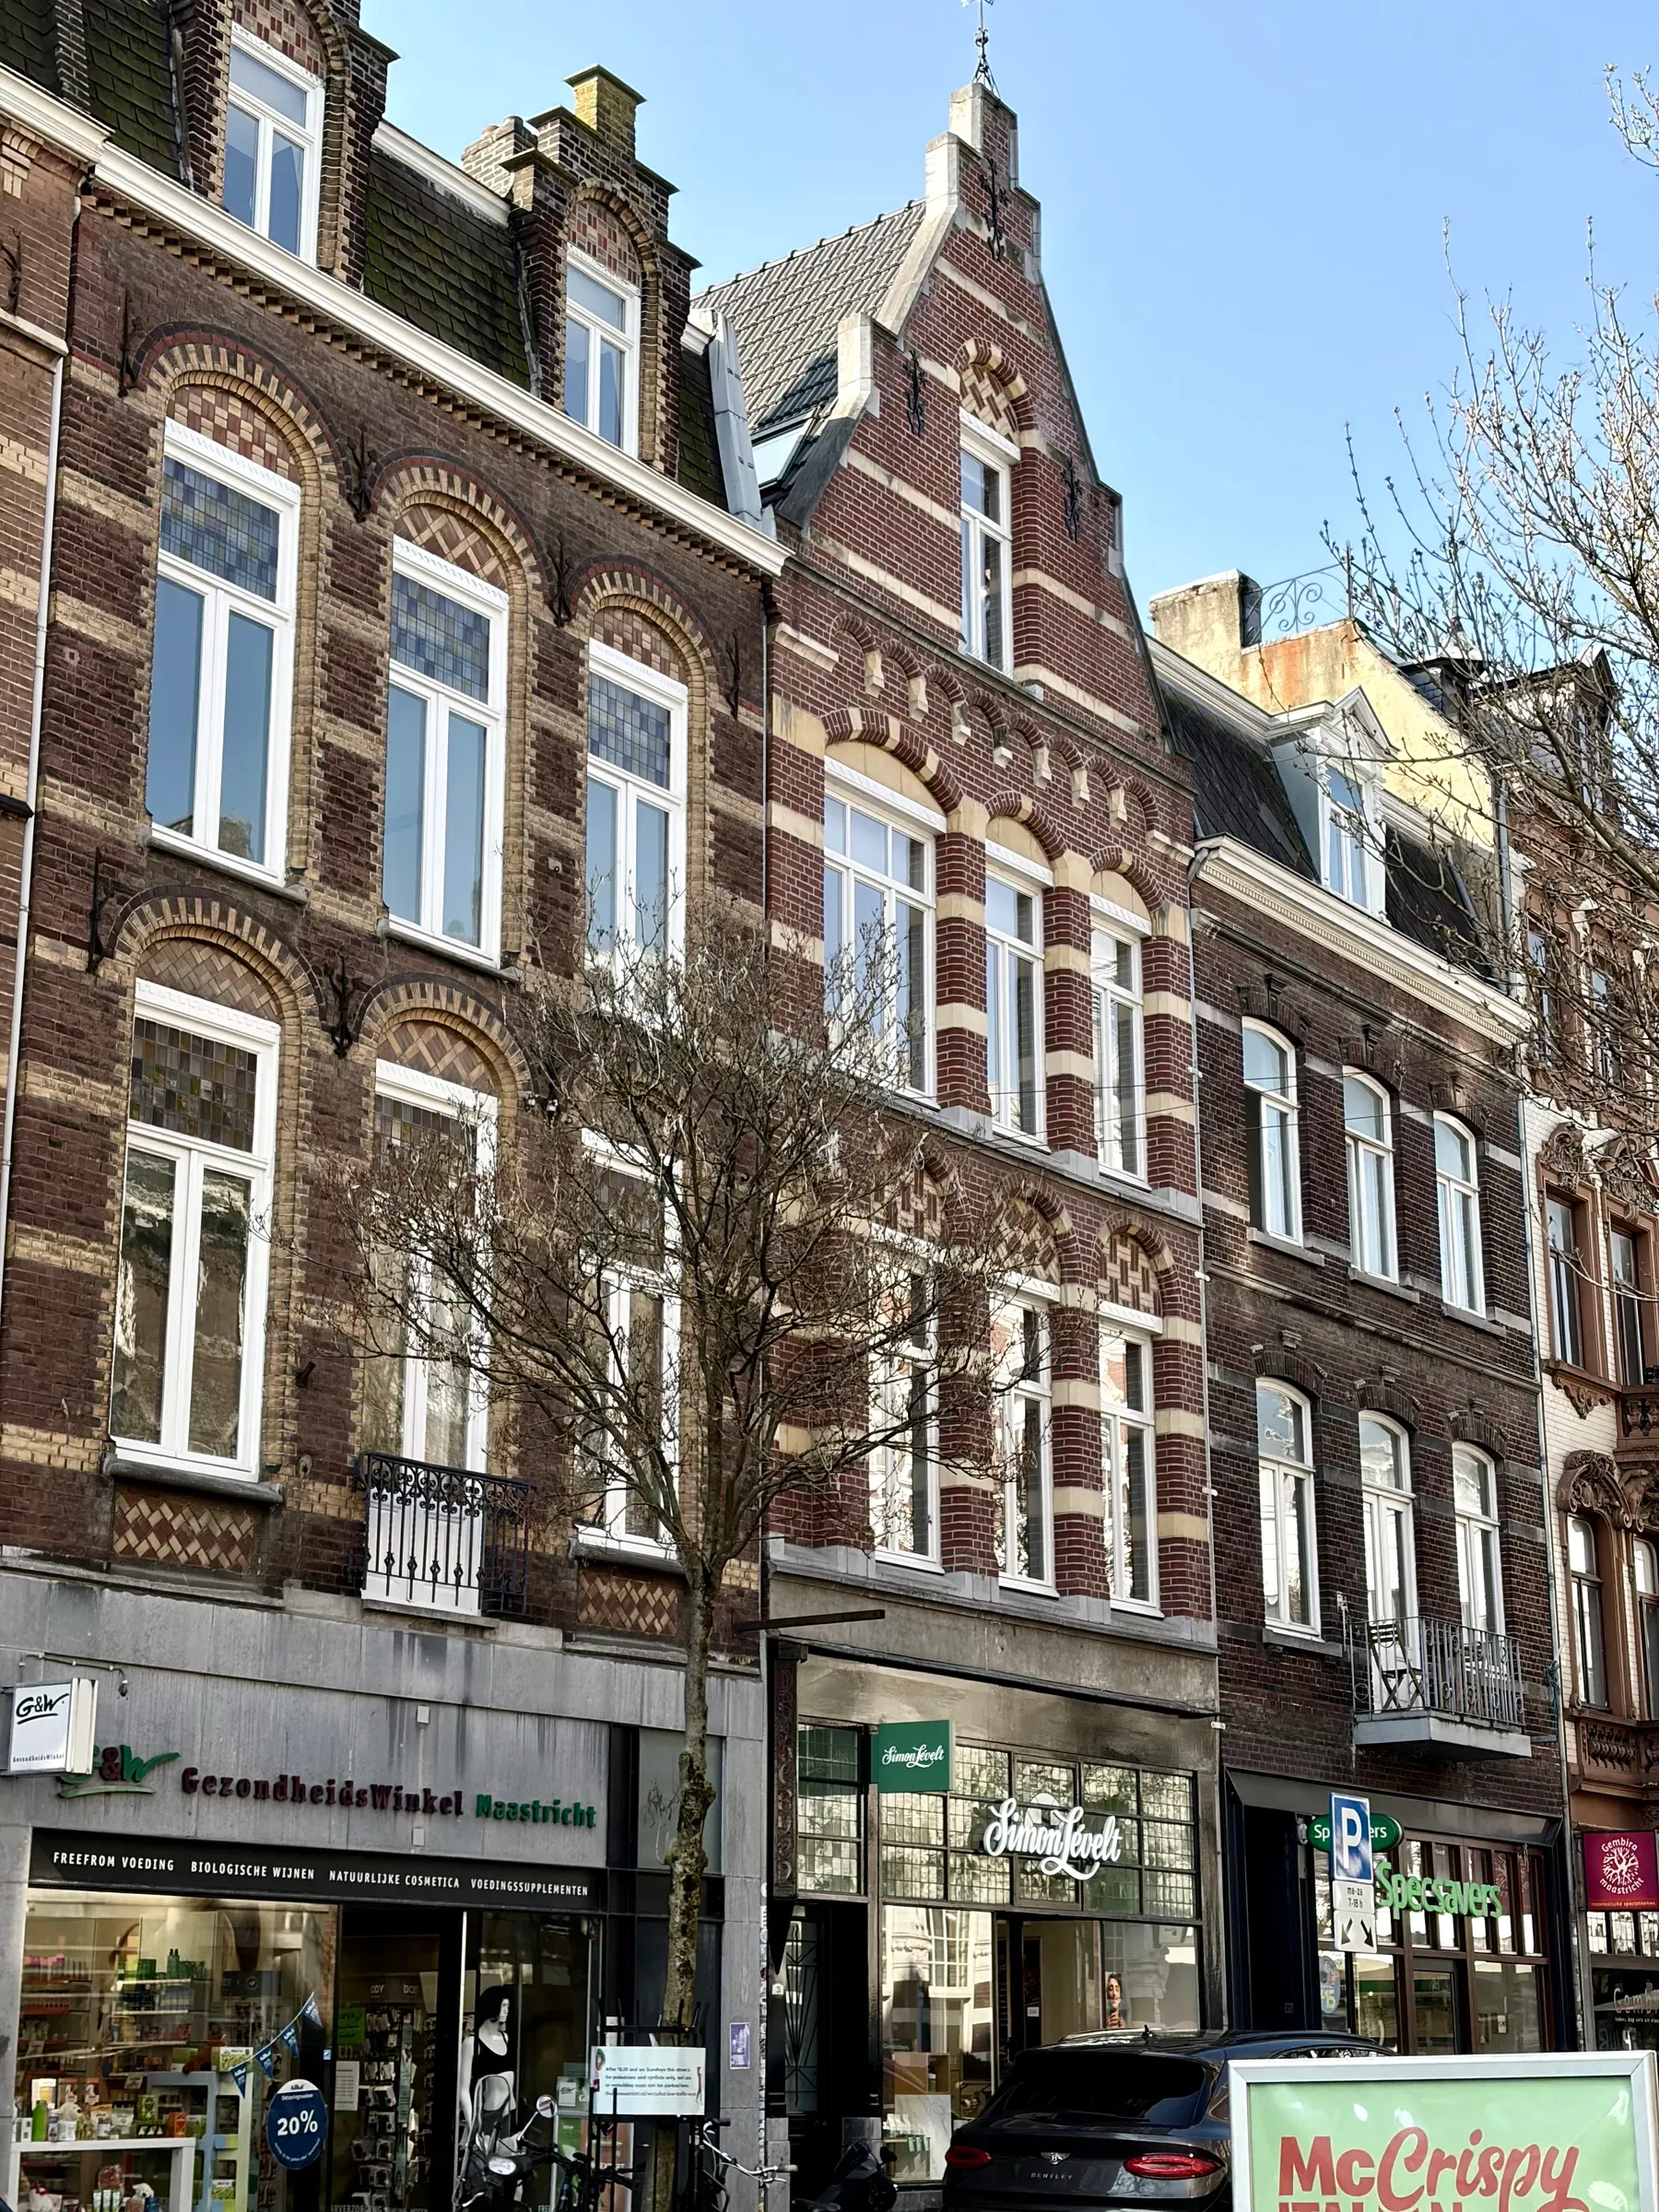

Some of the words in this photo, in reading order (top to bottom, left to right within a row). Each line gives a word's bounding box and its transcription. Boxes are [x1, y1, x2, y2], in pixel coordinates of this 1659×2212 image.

[16, 1693, 69, 1717] G&W
[182, 1767, 464, 1817] GezondheidsWinkel
[476, 1794, 597, 1829] Maastricht
[1341, 1806, 1362, 1869] P
[1601, 1836, 1638, 1853] Gembira
[53, 1852, 115, 1867] FREEFROM
[122, 1856, 174, 1871] VOEDING
[191, 1861, 267, 1877] BIOLOGISCHE
[273, 1866, 315, 1880] WIJNEN
[329, 1870, 400, 1885] NATUURLIJKE
[405, 1875, 460, 1888] COSMETICA
[471, 1878, 588, 1896] VOEDINGSSUPPLEMENTEN
[1599, 1877, 1644, 1895] maastricht
[1347, 1887, 1363, 1896] ma-za
[1375, 1862, 1502, 1920] Specsavers
[276, 2110, 318, 2136] 20%
[1030, 2172, 1073, 2181] BENTLEY
[1278, 2126, 1580, 2212] McCrispy
